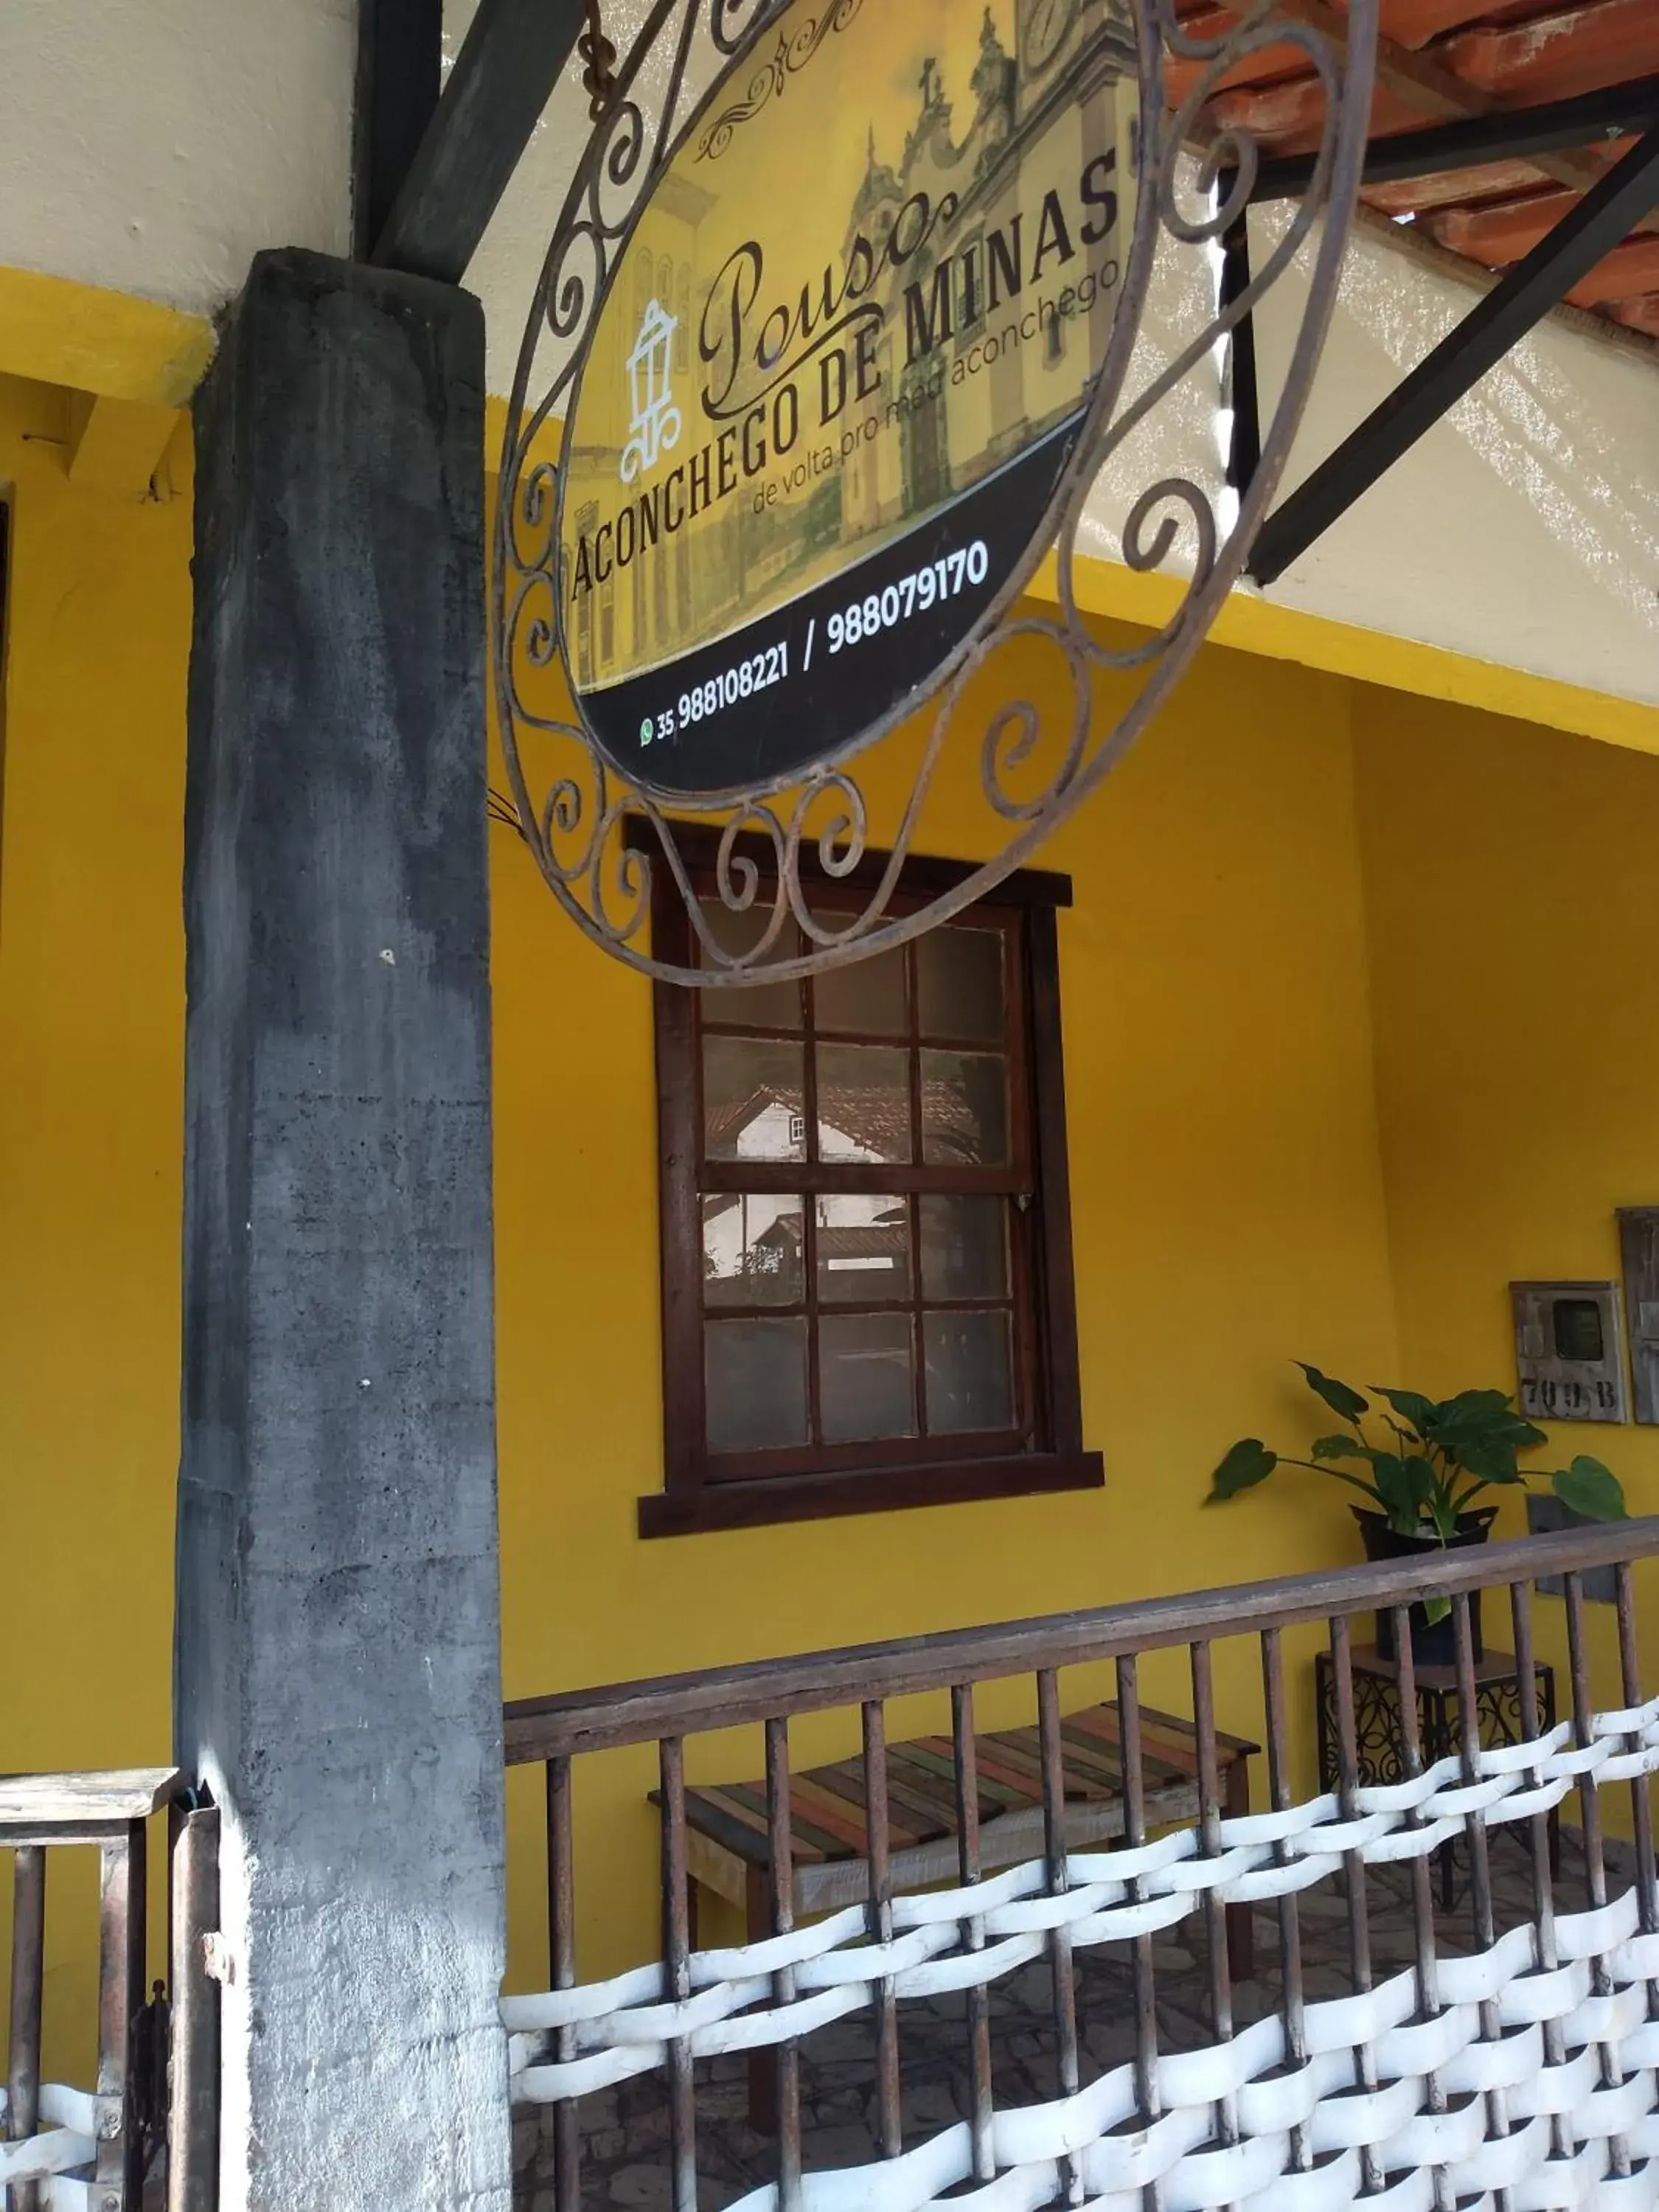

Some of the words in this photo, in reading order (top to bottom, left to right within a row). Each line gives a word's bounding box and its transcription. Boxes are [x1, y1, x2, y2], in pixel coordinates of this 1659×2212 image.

[571, 383, 798, 600] ACONCHEGO
[818, 320, 881, 426] DE
[903, 147, 1118, 369] MINAS
[700, 192, 958, 420] Pouso
[753, 482, 777, 515] de
[783, 445, 832, 494] volta
[841, 417, 878, 466] pro
[951, 260, 1119, 386] aconchego
[657, 710, 674, 739] 35
[678, 641, 787, 728] 988108221
[827, 540, 989, 654] 988079170
